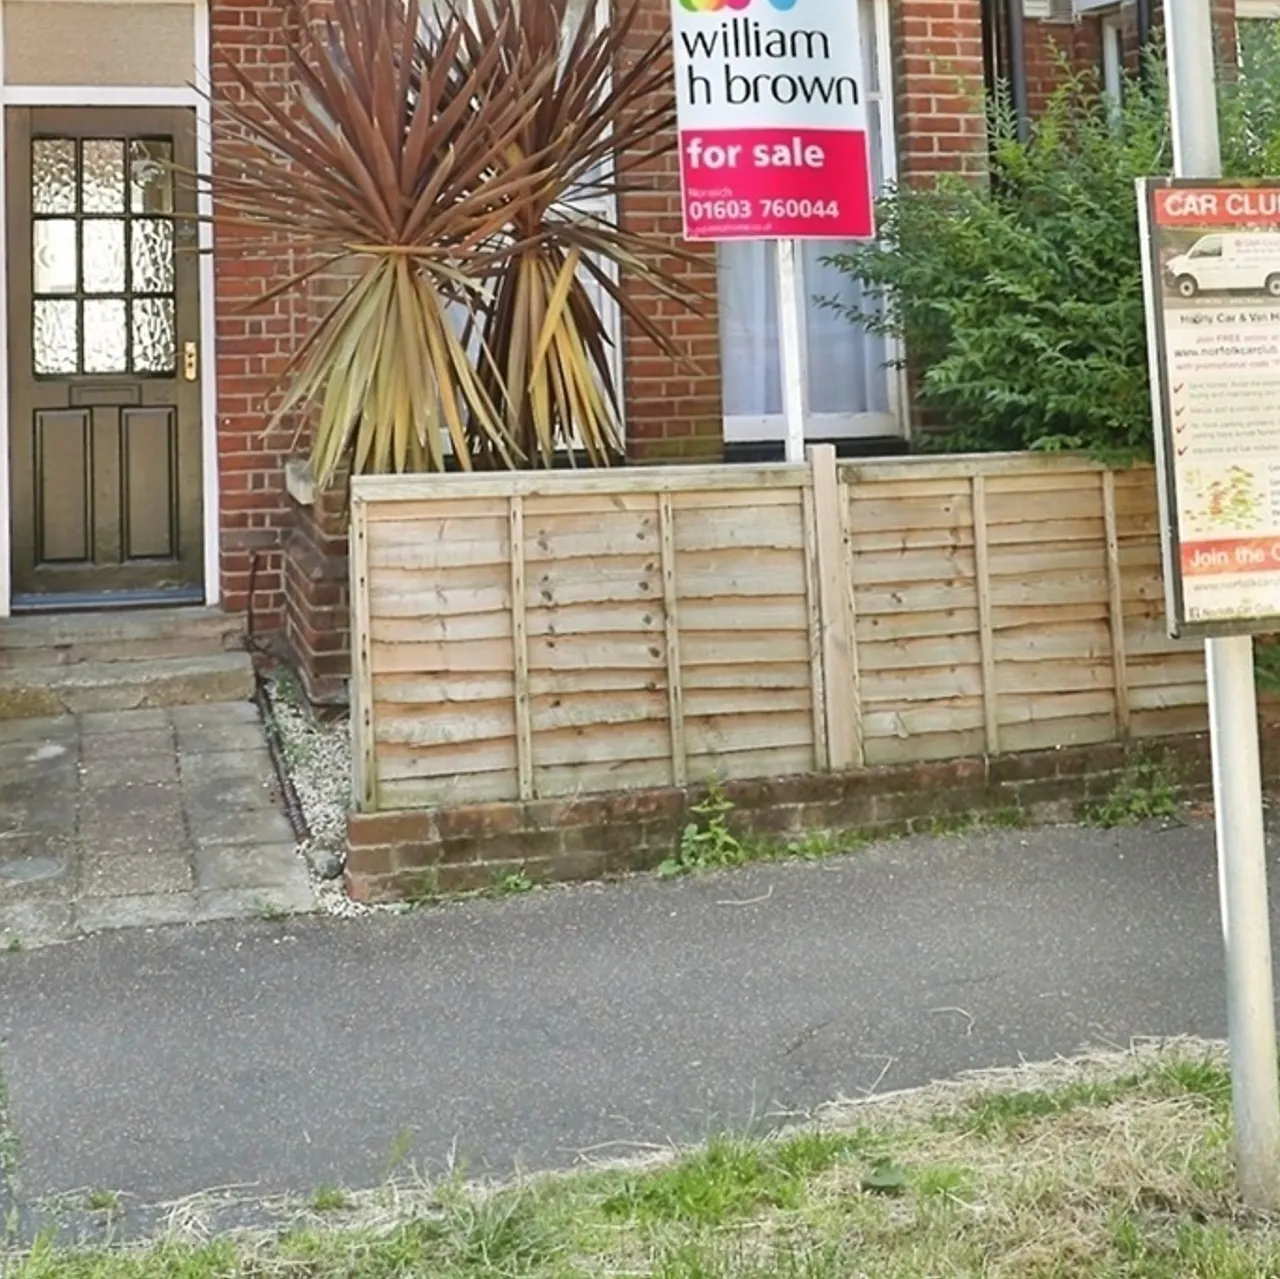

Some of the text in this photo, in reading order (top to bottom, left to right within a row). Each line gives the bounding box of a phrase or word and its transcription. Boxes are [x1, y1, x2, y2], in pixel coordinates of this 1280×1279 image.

[681, 17, 831, 59] william
[687, 64, 859, 105] h brown
[687, 136, 826, 169] for sale
[689, 199, 840, 220] 01603 760044
[1164, 194, 1218, 216] CAR
[1216, 312, 1236, 323] Car
[1249, 312, 1268, 321] Van
[1189, 548, 1229, 567] Join
[1235, 546, 1265, 564] the
